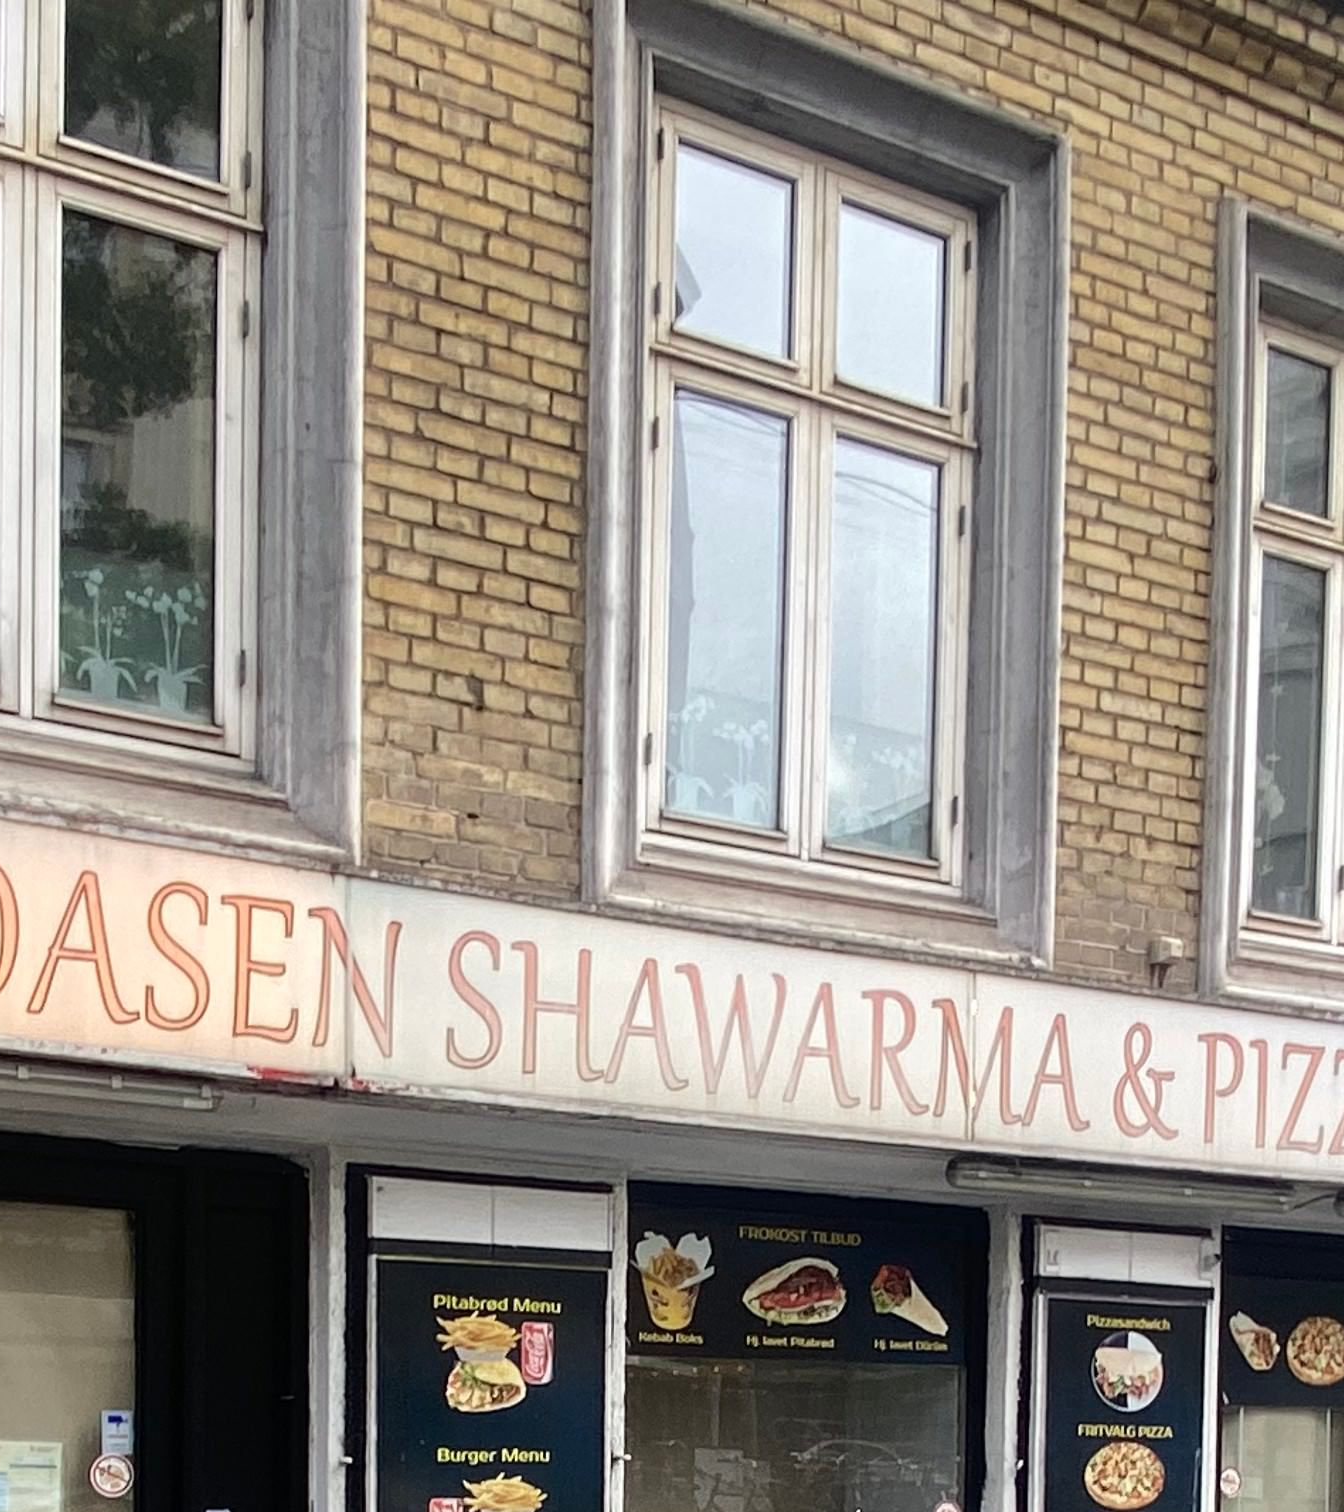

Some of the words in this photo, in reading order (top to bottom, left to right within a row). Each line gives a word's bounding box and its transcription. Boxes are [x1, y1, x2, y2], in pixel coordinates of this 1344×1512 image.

[443, 929, 1092, 1133] SHAWARMA
[1112, 1021, 1179, 1142] &
[738, 1225, 808, 1243] FROKOST
[811, 1230, 862, 1247] TILBUD
[433, 1293, 509, 1312] Pitabrød
[513, 1297, 562, 1315] Menu
[1086, 1314, 1172, 1331] Pizzasandwich
[1077, 1423, 1137, 1438] FRITVALG
[1137, 1425, 1174, 1439] PIZZA
[436, 1447, 497, 1466] Burger
[501, 1447, 551, 1463] Menu
